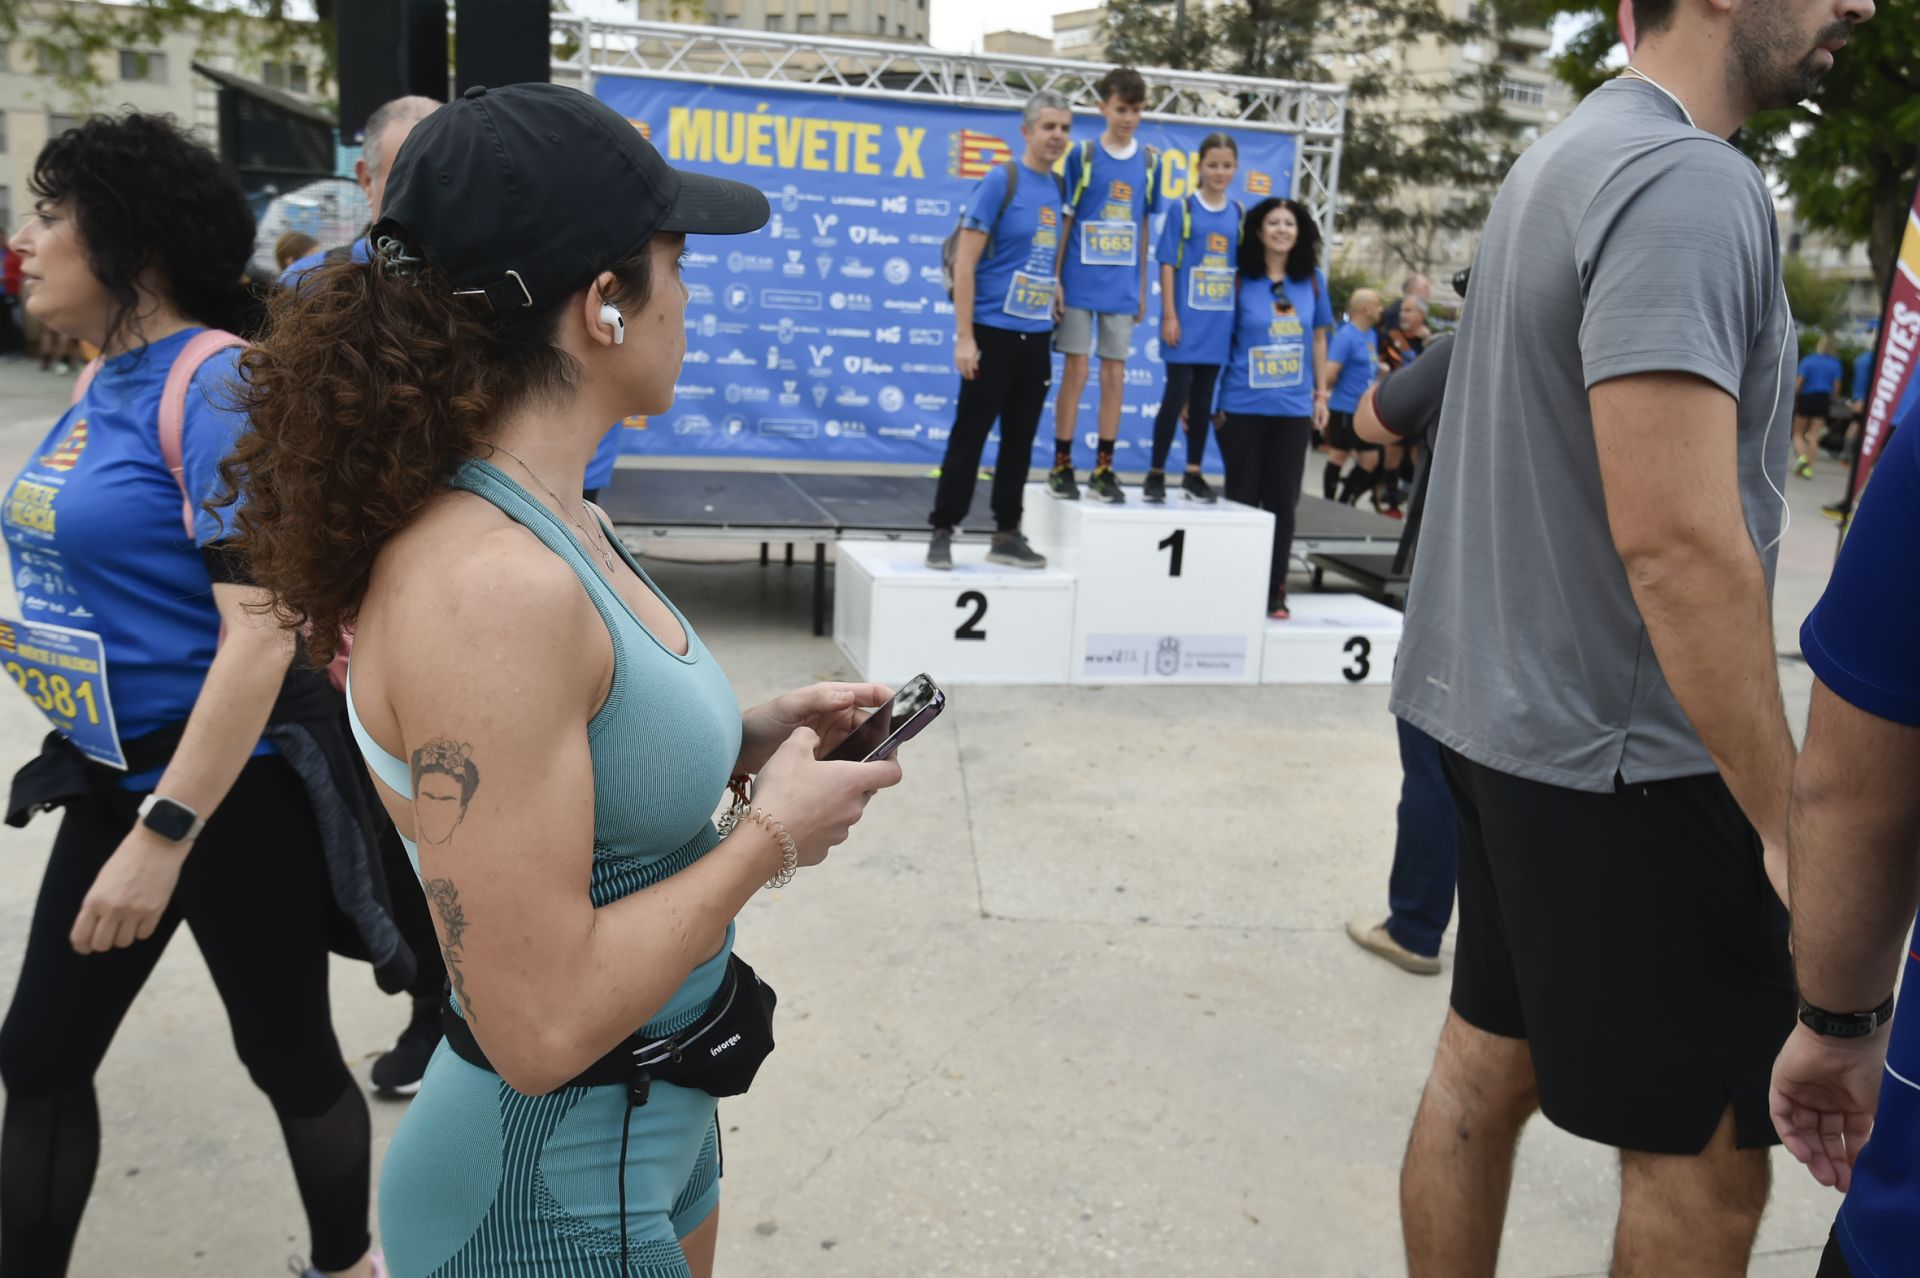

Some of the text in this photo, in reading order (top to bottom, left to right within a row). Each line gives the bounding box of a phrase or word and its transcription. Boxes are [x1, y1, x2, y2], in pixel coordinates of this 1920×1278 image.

[668, 104, 926, 178] MUÉVETE X
[1158, 529, 1186, 577] 1
[954, 590, 988, 641] 2
[1342, 636, 1372, 682] 3
